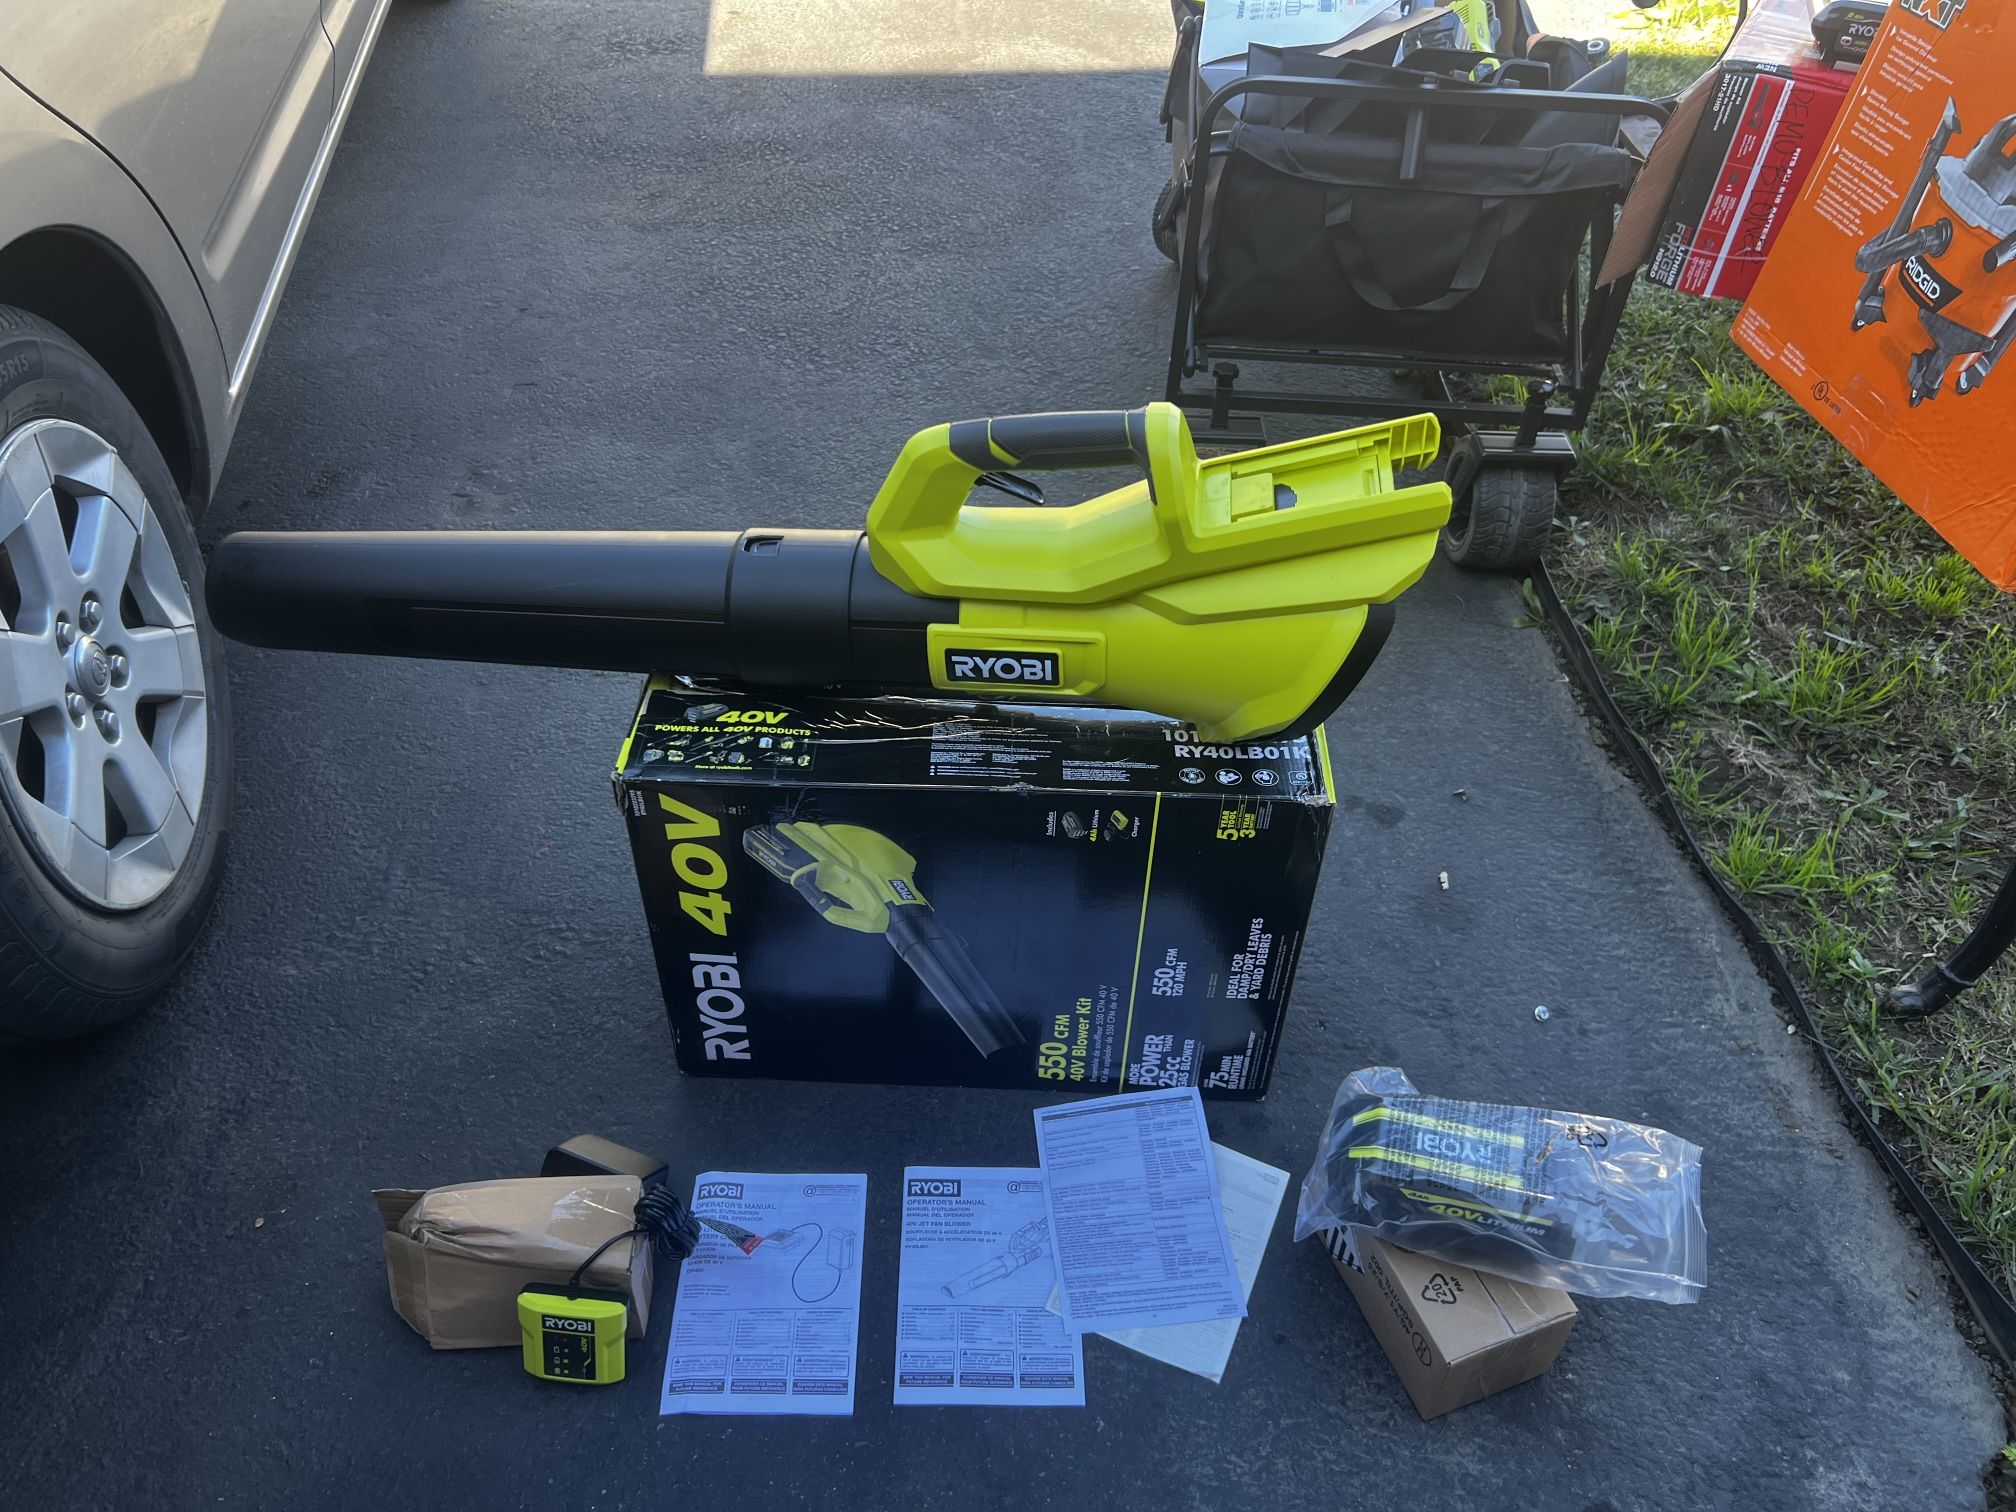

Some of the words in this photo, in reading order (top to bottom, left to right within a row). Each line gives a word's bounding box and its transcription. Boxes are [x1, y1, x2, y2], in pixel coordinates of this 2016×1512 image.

[1849, 24, 1878, 37] RYO
[1653, 222, 1687, 282] FORGE
[1905, 256, 1941, 300] RIDGID
[951, 656, 1052, 680] RYOBI
[716, 711, 788, 724] 40V
[755, 727, 810, 736] PRODUCTS
[1162, 729, 1199, 743] 101
[1174, 745, 1312, 759] RY40LB01K
[1046, 811, 1054, 836] Includes
[1220, 811, 1230, 828] YEAR
[1228, 811, 1237, 828] TOOL
[1216, 830, 1238, 841] 5
[1240, 830, 1256, 839] 3
[658, 793, 732, 936] 40V
[1237, 952, 1256, 1000] DAMP/DRY
[1247, 917, 1264, 952] LEAVES
[1256, 933, 1272, 965] DEBRIS
[1152, 968, 1175, 997] 550
[1165, 948, 1178, 966] CFM
[1176, 962, 1188, 978] MPH
[1232, 953, 1245, 972] FOR
[1226, 974, 1240, 999] IDEAL
[1251, 965, 1266, 990] YARD
[1172, 980, 1184, 997] 120
[1249, 991, 1259, 1000] &
[690, 952, 751, 1060] RYOBI
[1078, 997, 1092, 1014] Kit
[1073, 1016, 1089, 1055] Blower
[1163, 1035, 1174, 1052] THAN
[1038, 1041, 1068, 1080] 550
[1054, 1014, 1070, 1038] CFM
[1180, 1039, 1195, 1070] BLOWER
[1070, 1057, 1084, 1082] 40V
[1139, 1035, 1164, 1086] POWER
[1129, 1063, 1141, 1084] MORE
[1178, 1072, 1189, 1087] GAS
[1209, 1071, 1229, 1088] 75
[1221, 1056, 1232, 1071] MIN
[1228, 1055, 1243, 1089] RUNTIME
[1417, 1132, 1494, 1164] RYOBI
[701, 1185, 740, 1197] RYOBI
[910, 1182, 957, 1194] RYOBI
[1428, 1205, 1481, 1220] 40V
[1477, 1216, 1546, 1236] LITHIUM
[1432, 1284, 1447, 1298] 20
[1451, 1277, 1463, 1292] PAP
[544, 1317, 592, 1332] RYOBI
